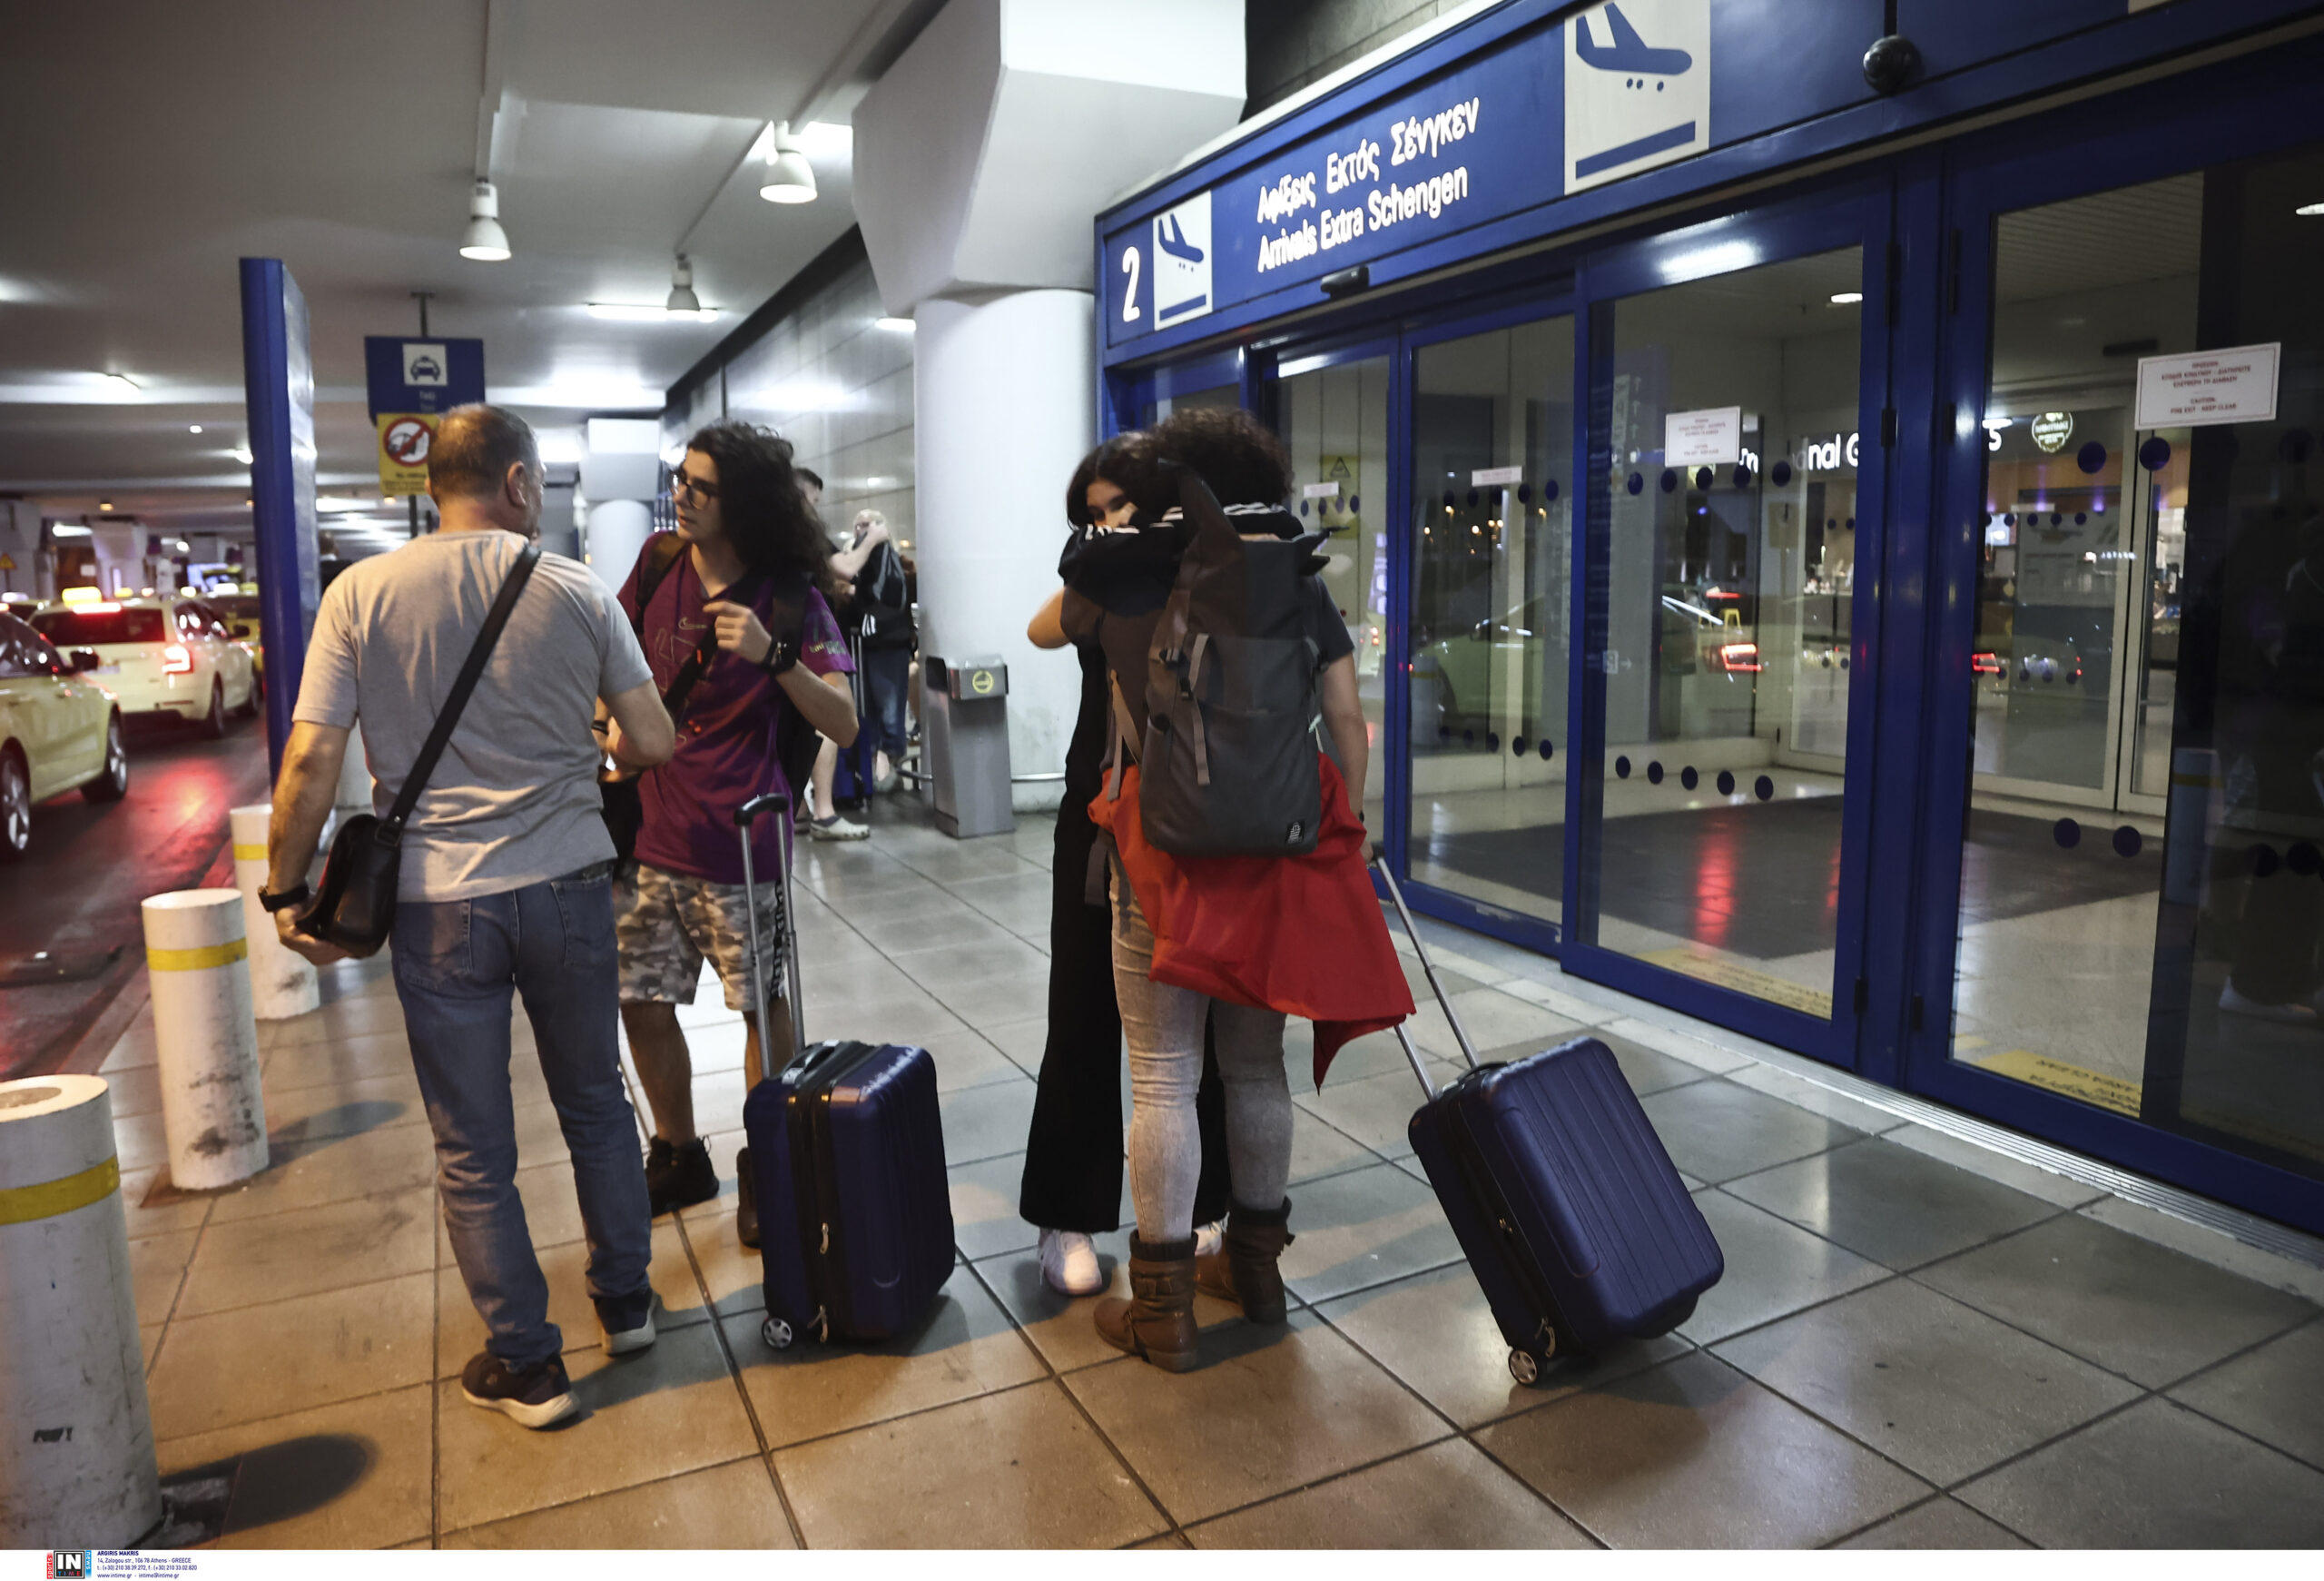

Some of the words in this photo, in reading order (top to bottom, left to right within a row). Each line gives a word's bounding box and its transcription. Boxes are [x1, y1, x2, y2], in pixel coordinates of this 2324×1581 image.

[1257, 170, 1316, 224] Αφίξεις
[1326, 138, 1380, 194] Εκτός
[1390, 97, 1479, 168] Σένγκεν
[1257, 220, 1317, 272] Arrivals
[1320, 204, 1364, 251] Extra
[1368, 166, 1468, 232] Schengen
[1122, 246, 1140, 322] 2
